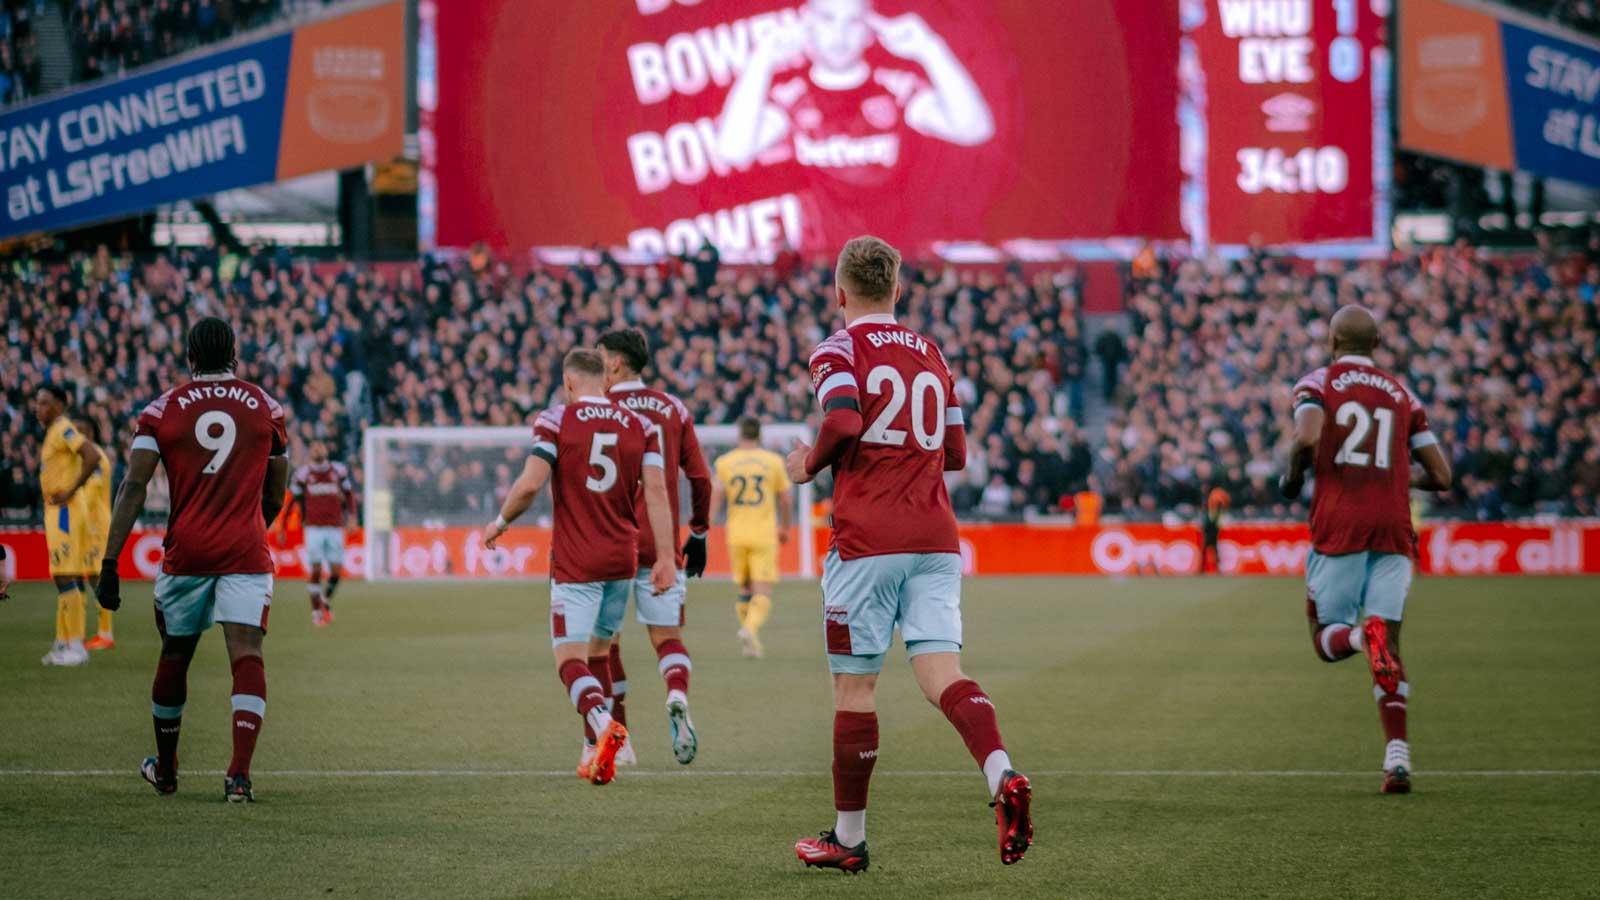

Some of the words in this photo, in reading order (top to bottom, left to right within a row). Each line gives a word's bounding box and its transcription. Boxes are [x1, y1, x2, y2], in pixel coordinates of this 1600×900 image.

[1219, 0, 1313, 37] WHU
[1238, 38, 1314, 84] EVE
[1329, 36, 1363, 82] 0
[58, 59, 265, 153] CONNECTED
[8, 176, 45, 221] at
[47, 114, 247, 209] LSFreeWIFI
[1236, 147, 1349, 194] 34:10
[866, 330, 928, 356] BOWEN
[177, 386, 260, 411] ANTONIO
[618, 396, 674, 420] AQUETA
[860, 365, 945, 451] 20
[1331, 369, 1403, 404] OGBONNA
[575, 405, 630, 429] COUFAL
[1333, 400, 1393, 469] 21
[194, 410, 237, 474] 9
[585, 432, 619, 493] 5
[730, 474, 766, 507] 23
[464, 528, 534, 577] for
[1092, 529, 1197, 573] One
[1429, 526, 1508, 574] for
[1516, 526, 1583, 574] all
